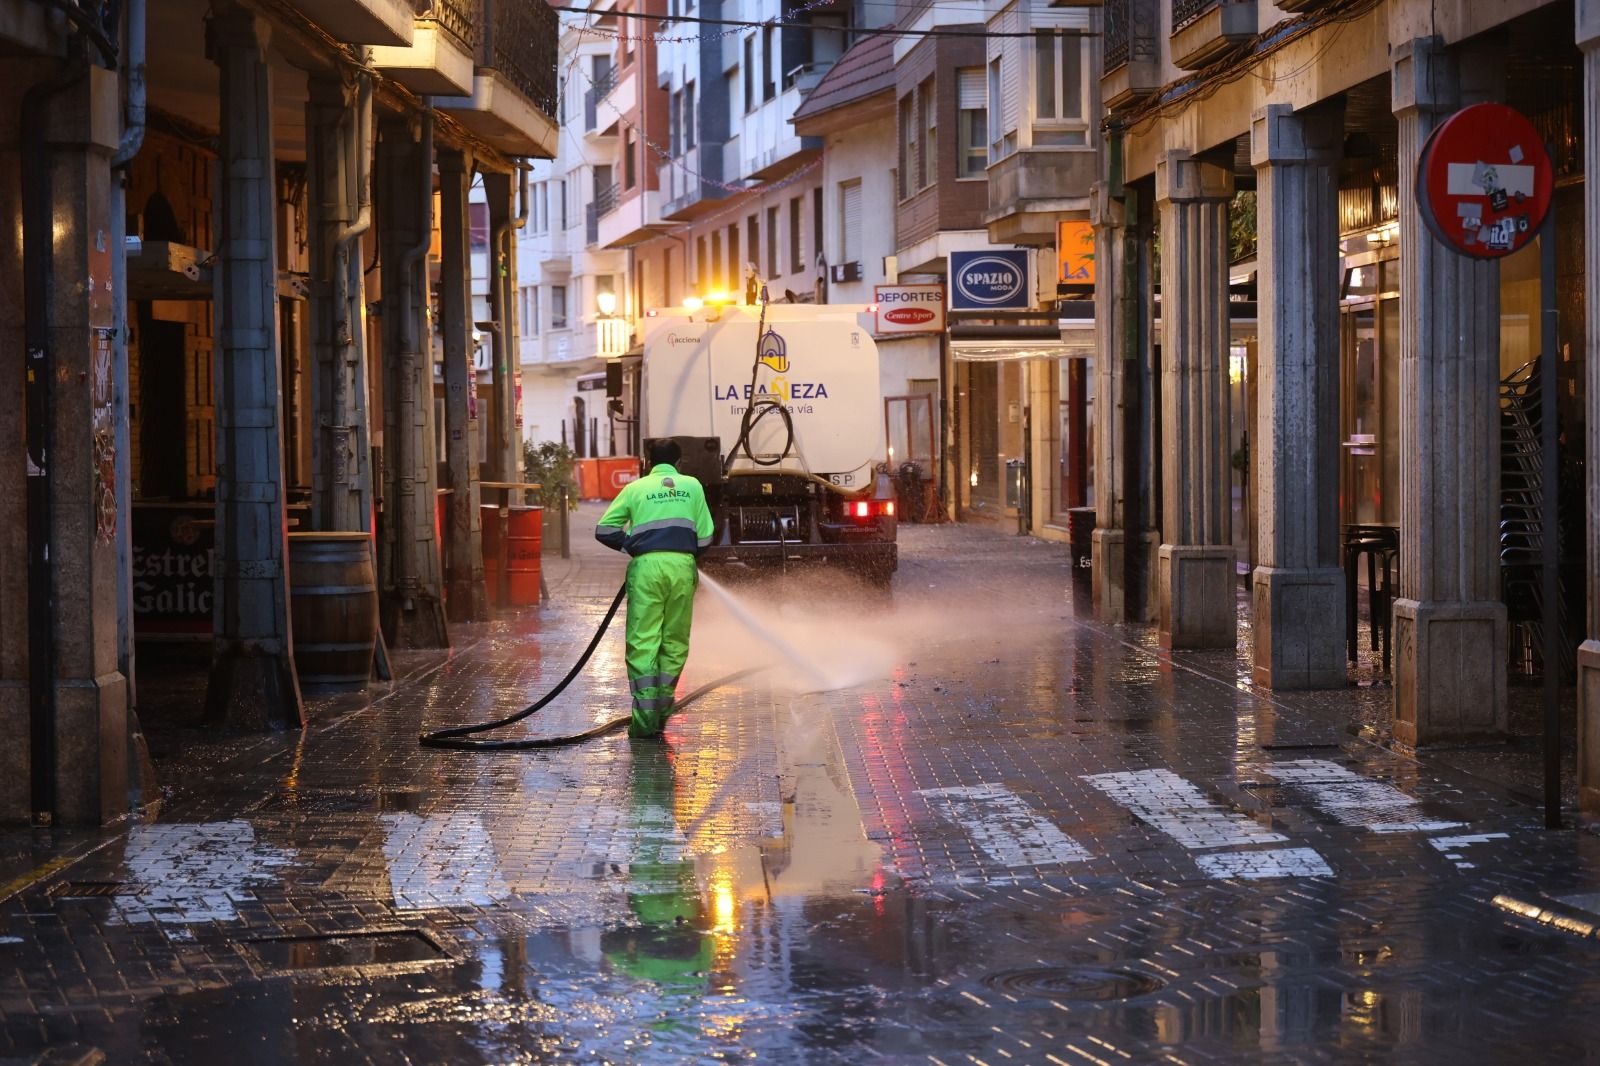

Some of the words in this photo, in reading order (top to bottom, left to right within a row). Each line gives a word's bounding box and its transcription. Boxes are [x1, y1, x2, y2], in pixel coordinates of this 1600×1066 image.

[966, 272, 1013, 285] SPAZIO
[877, 291, 943, 303] DEPORTES
[912, 312, 933, 321] Sport
[715, 385, 739, 400] LA
[797, 403, 814, 414] vía
